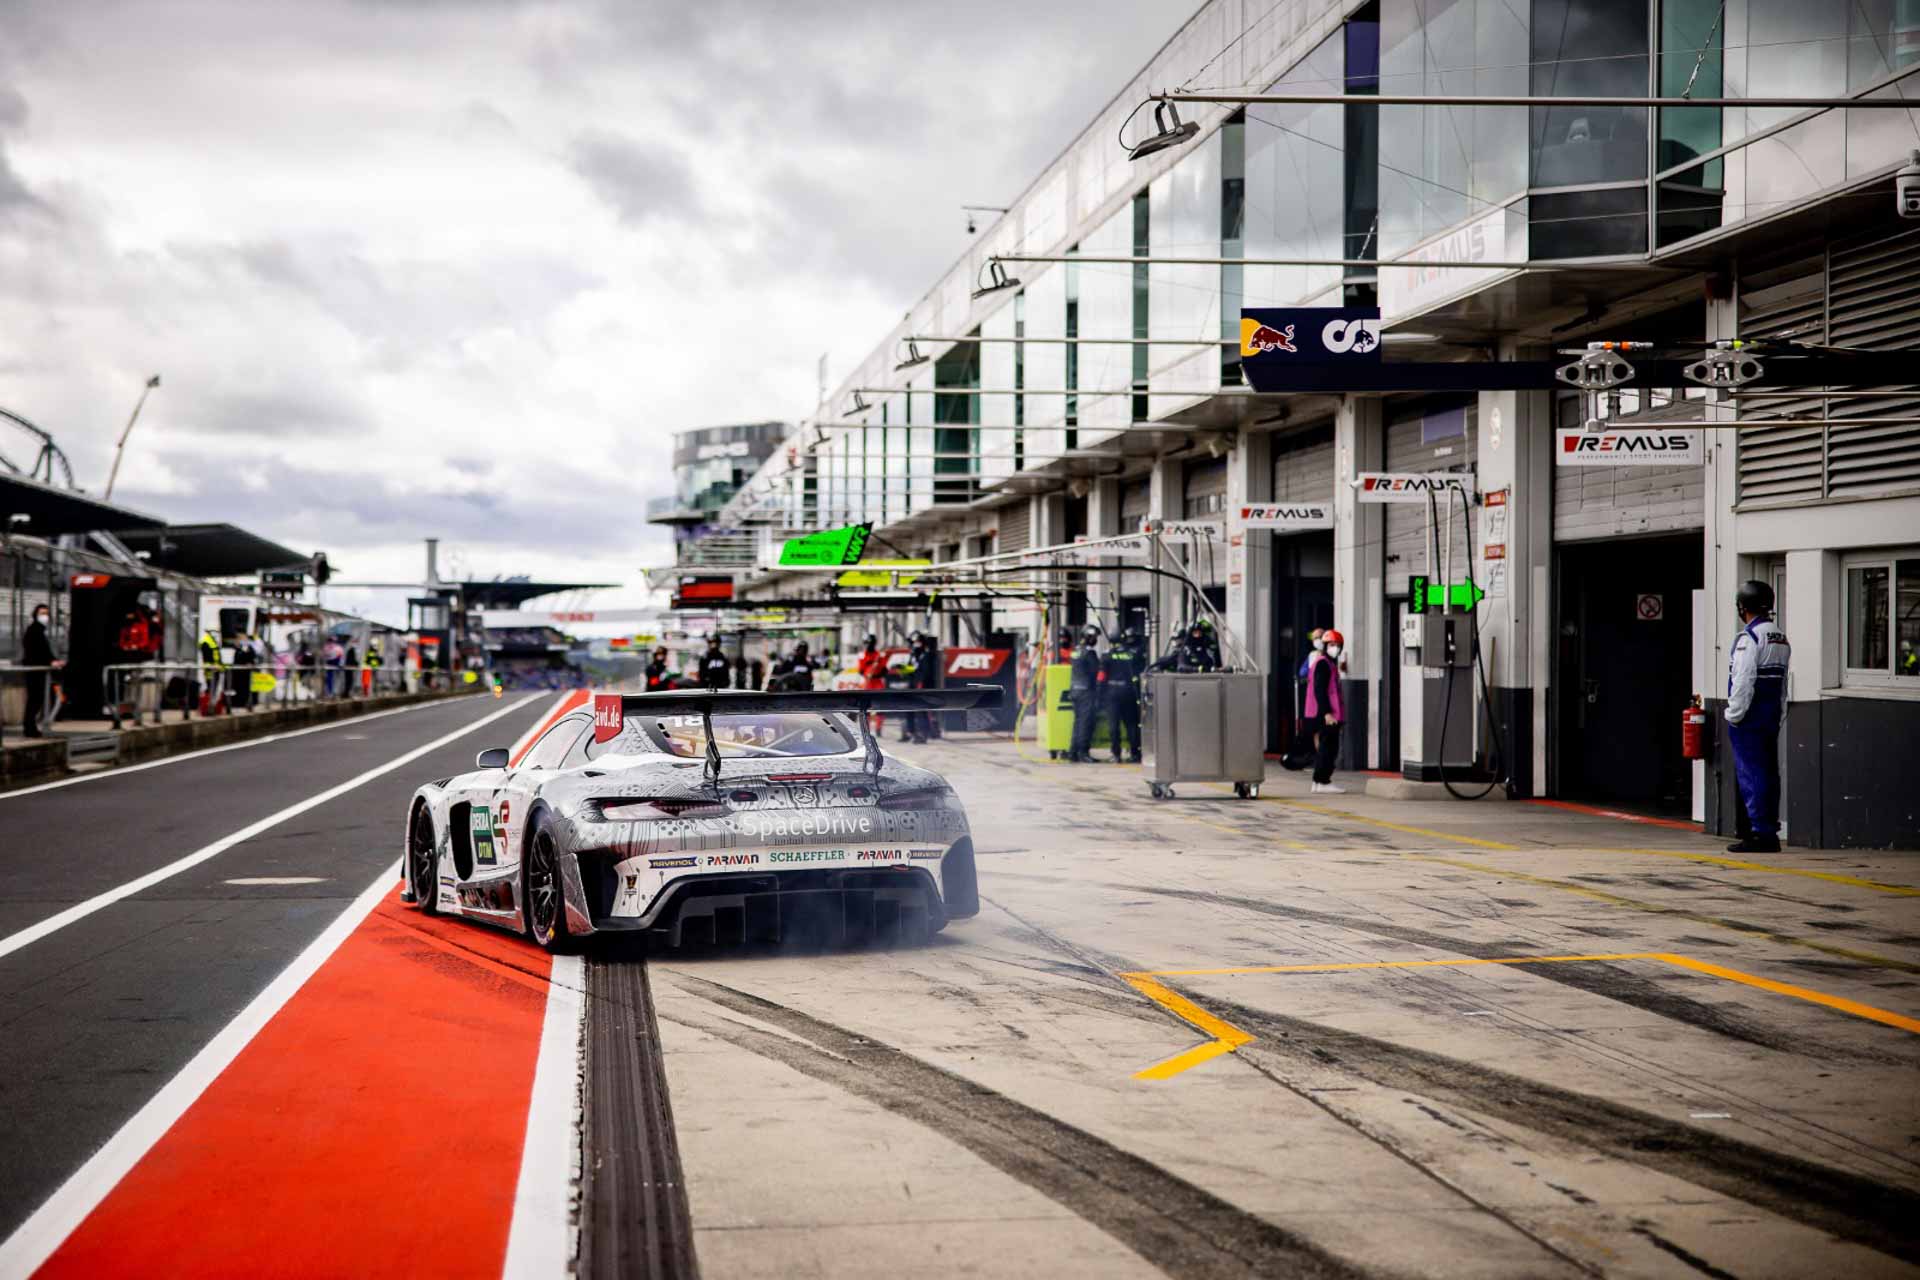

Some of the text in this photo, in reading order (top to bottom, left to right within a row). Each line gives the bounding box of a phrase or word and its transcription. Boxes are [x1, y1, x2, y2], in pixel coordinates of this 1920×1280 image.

[1578, 436, 1689, 452] REMUS
[1250, 508, 1324, 519] REMUS
[948, 653, 994, 674] ABT
[595, 704, 620, 728] avd.de
[743, 814, 870, 842] SpaceDrive
[708, 854, 759, 866] PARAVAN
[770, 850, 845, 862] SCHAEFFLER
[857, 850, 901, 861] PARAVAN
